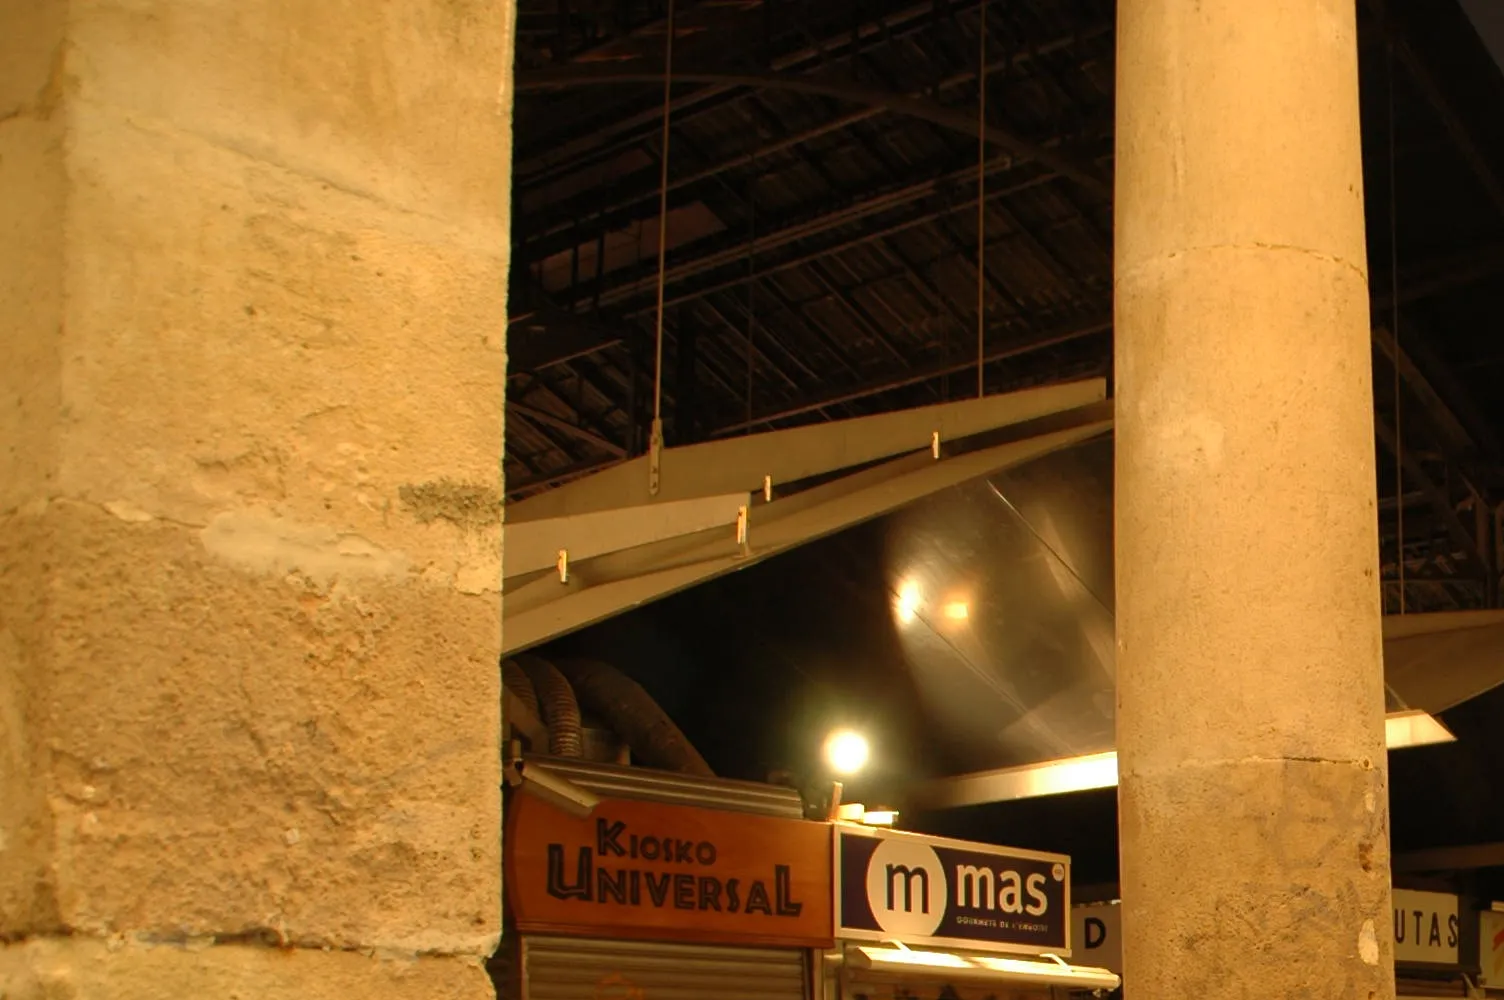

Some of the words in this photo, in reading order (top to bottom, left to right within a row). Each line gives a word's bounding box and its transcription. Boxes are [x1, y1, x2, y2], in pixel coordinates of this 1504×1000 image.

[596, 817, 717, 866] KIOSKO
[546, 843, 803, 917] UNIVERSAL
[956, 864, 1048, 916] mas
